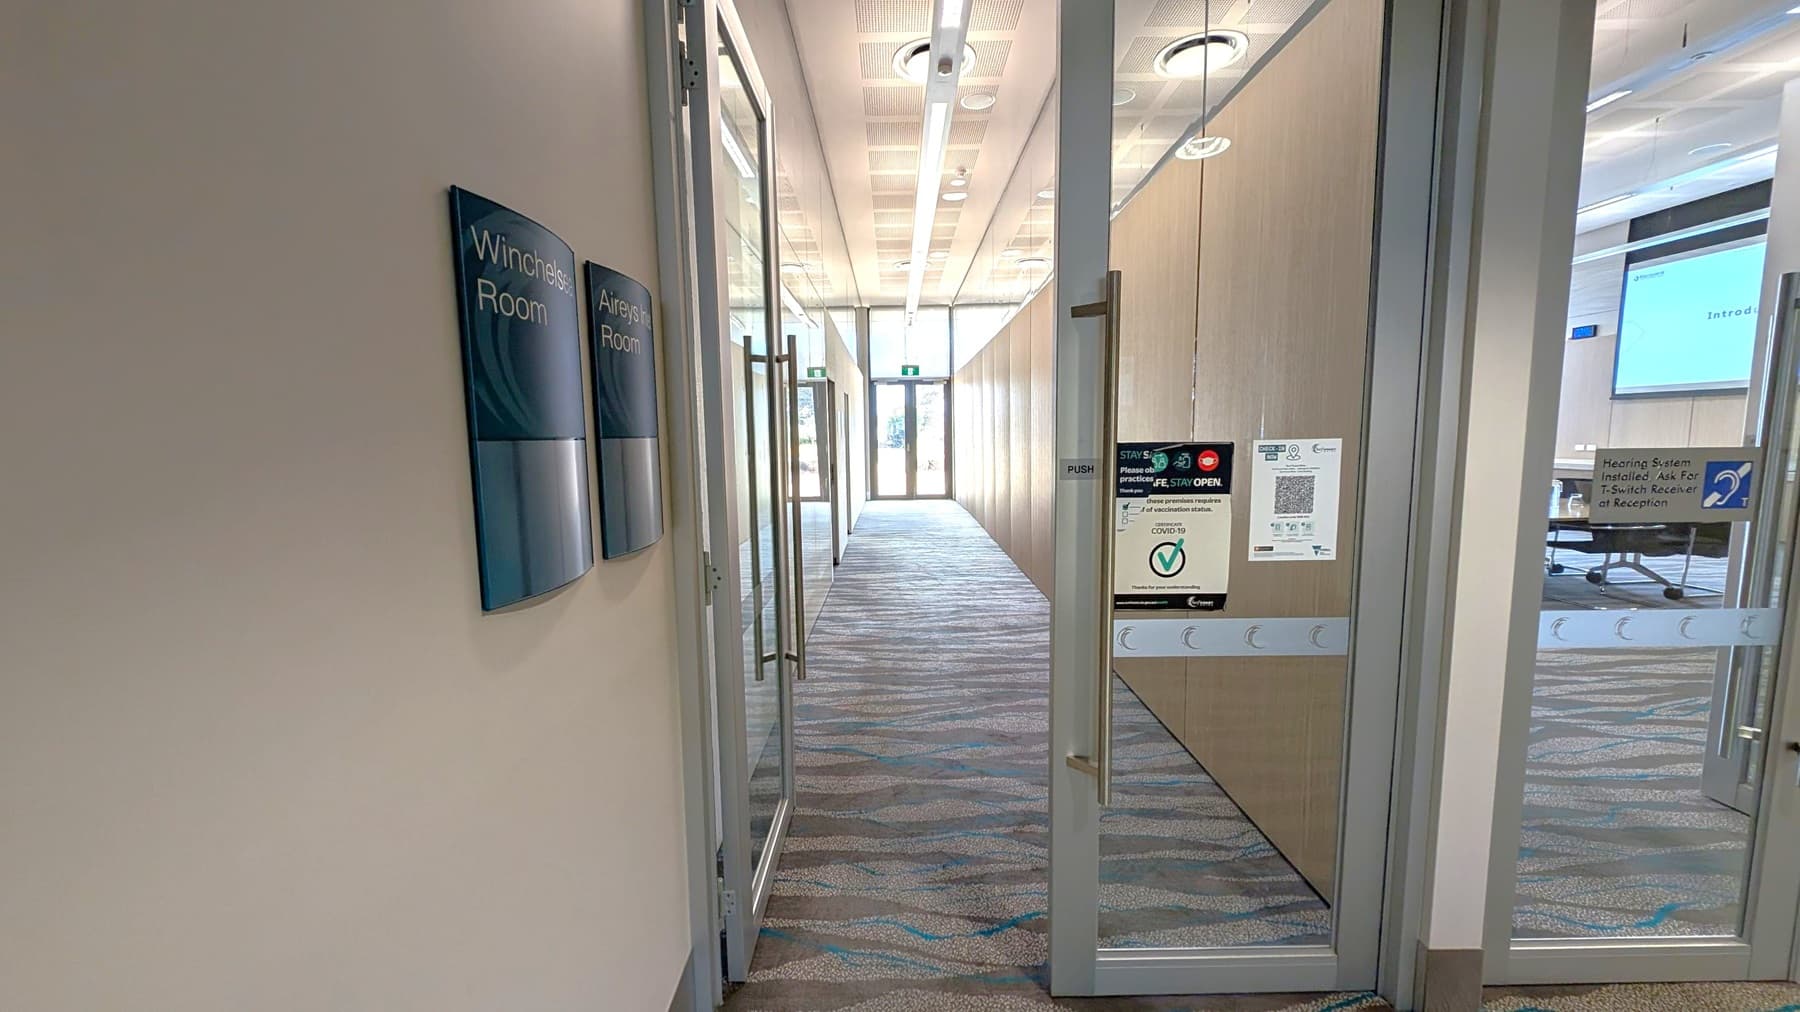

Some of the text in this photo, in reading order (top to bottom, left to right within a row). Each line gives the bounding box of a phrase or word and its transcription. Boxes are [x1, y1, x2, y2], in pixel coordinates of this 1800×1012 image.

[477, 278, 548, 326] Room
[599, 289, 640, 325] Aireys
[601, 324, 641, 354] Room
[1120, 450, 1142, 459] STAY
[1603, 457, 1691, 470] Hearing System
[1067, 464, 1094, 474] PUSH
[1120, 475, 1154, 484] practices
[1656, 471, 1676, 481] Ask
[1681, 471, 1699, 481] For
[1170, 478, 1193, 487] STAY
[1193, 477, 1223, 487] OPEN.
[1601, 484, 1698, 494] T-Switch Receiver
[1165, 497, 1194, 505] premises
[1195, 497, 1222, 505] requires
[1599, 498, 1668, 509] at Reception
[1740, 497, 1750, 507] T
[1151, 527, 1186, 535] COVID-19
